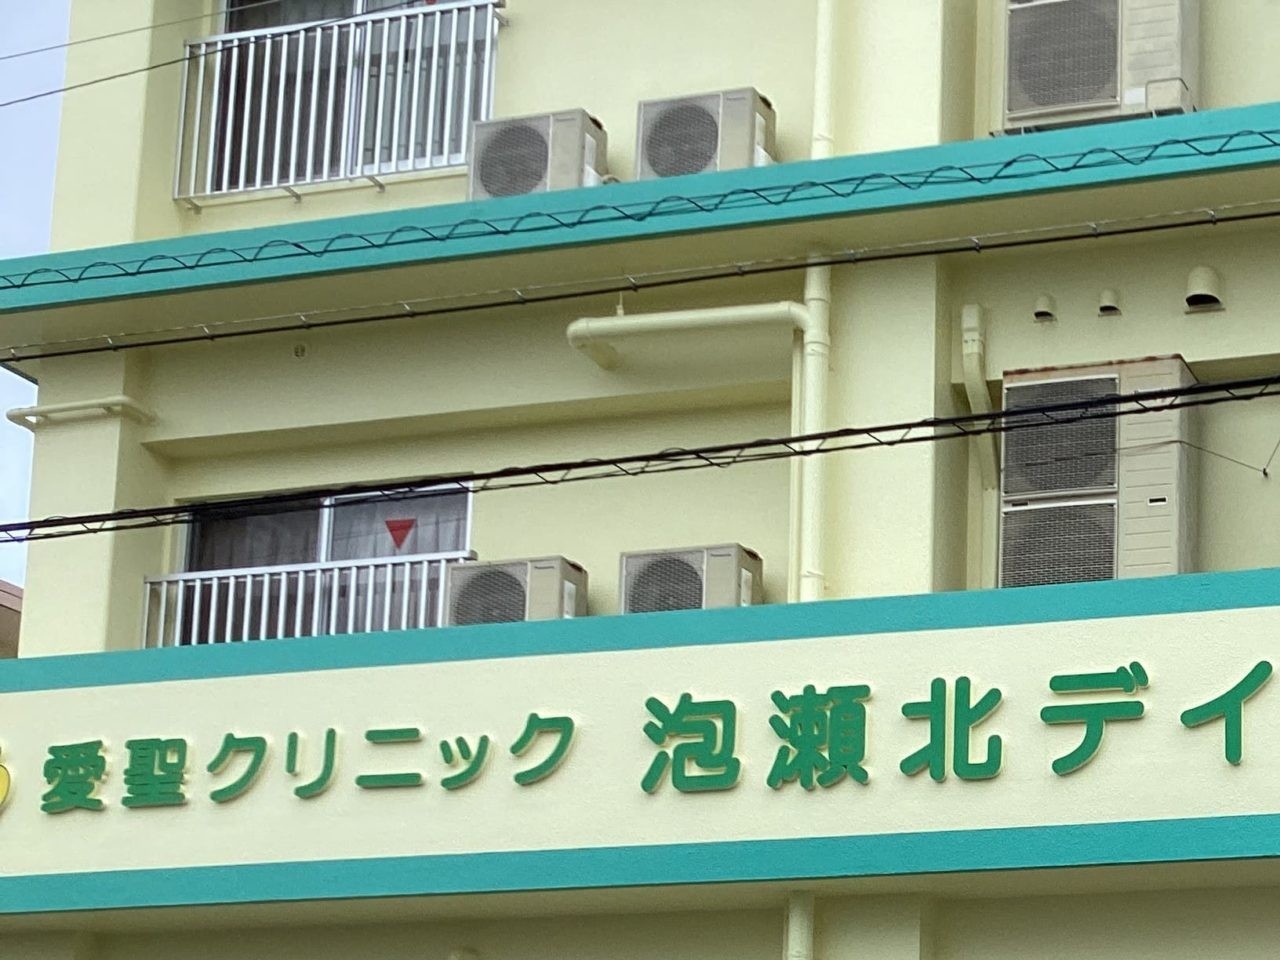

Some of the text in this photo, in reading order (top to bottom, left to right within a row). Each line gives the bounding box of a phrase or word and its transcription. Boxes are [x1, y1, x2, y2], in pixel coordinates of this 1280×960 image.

[41, 712, 577, 815] 愛聖クリニック
